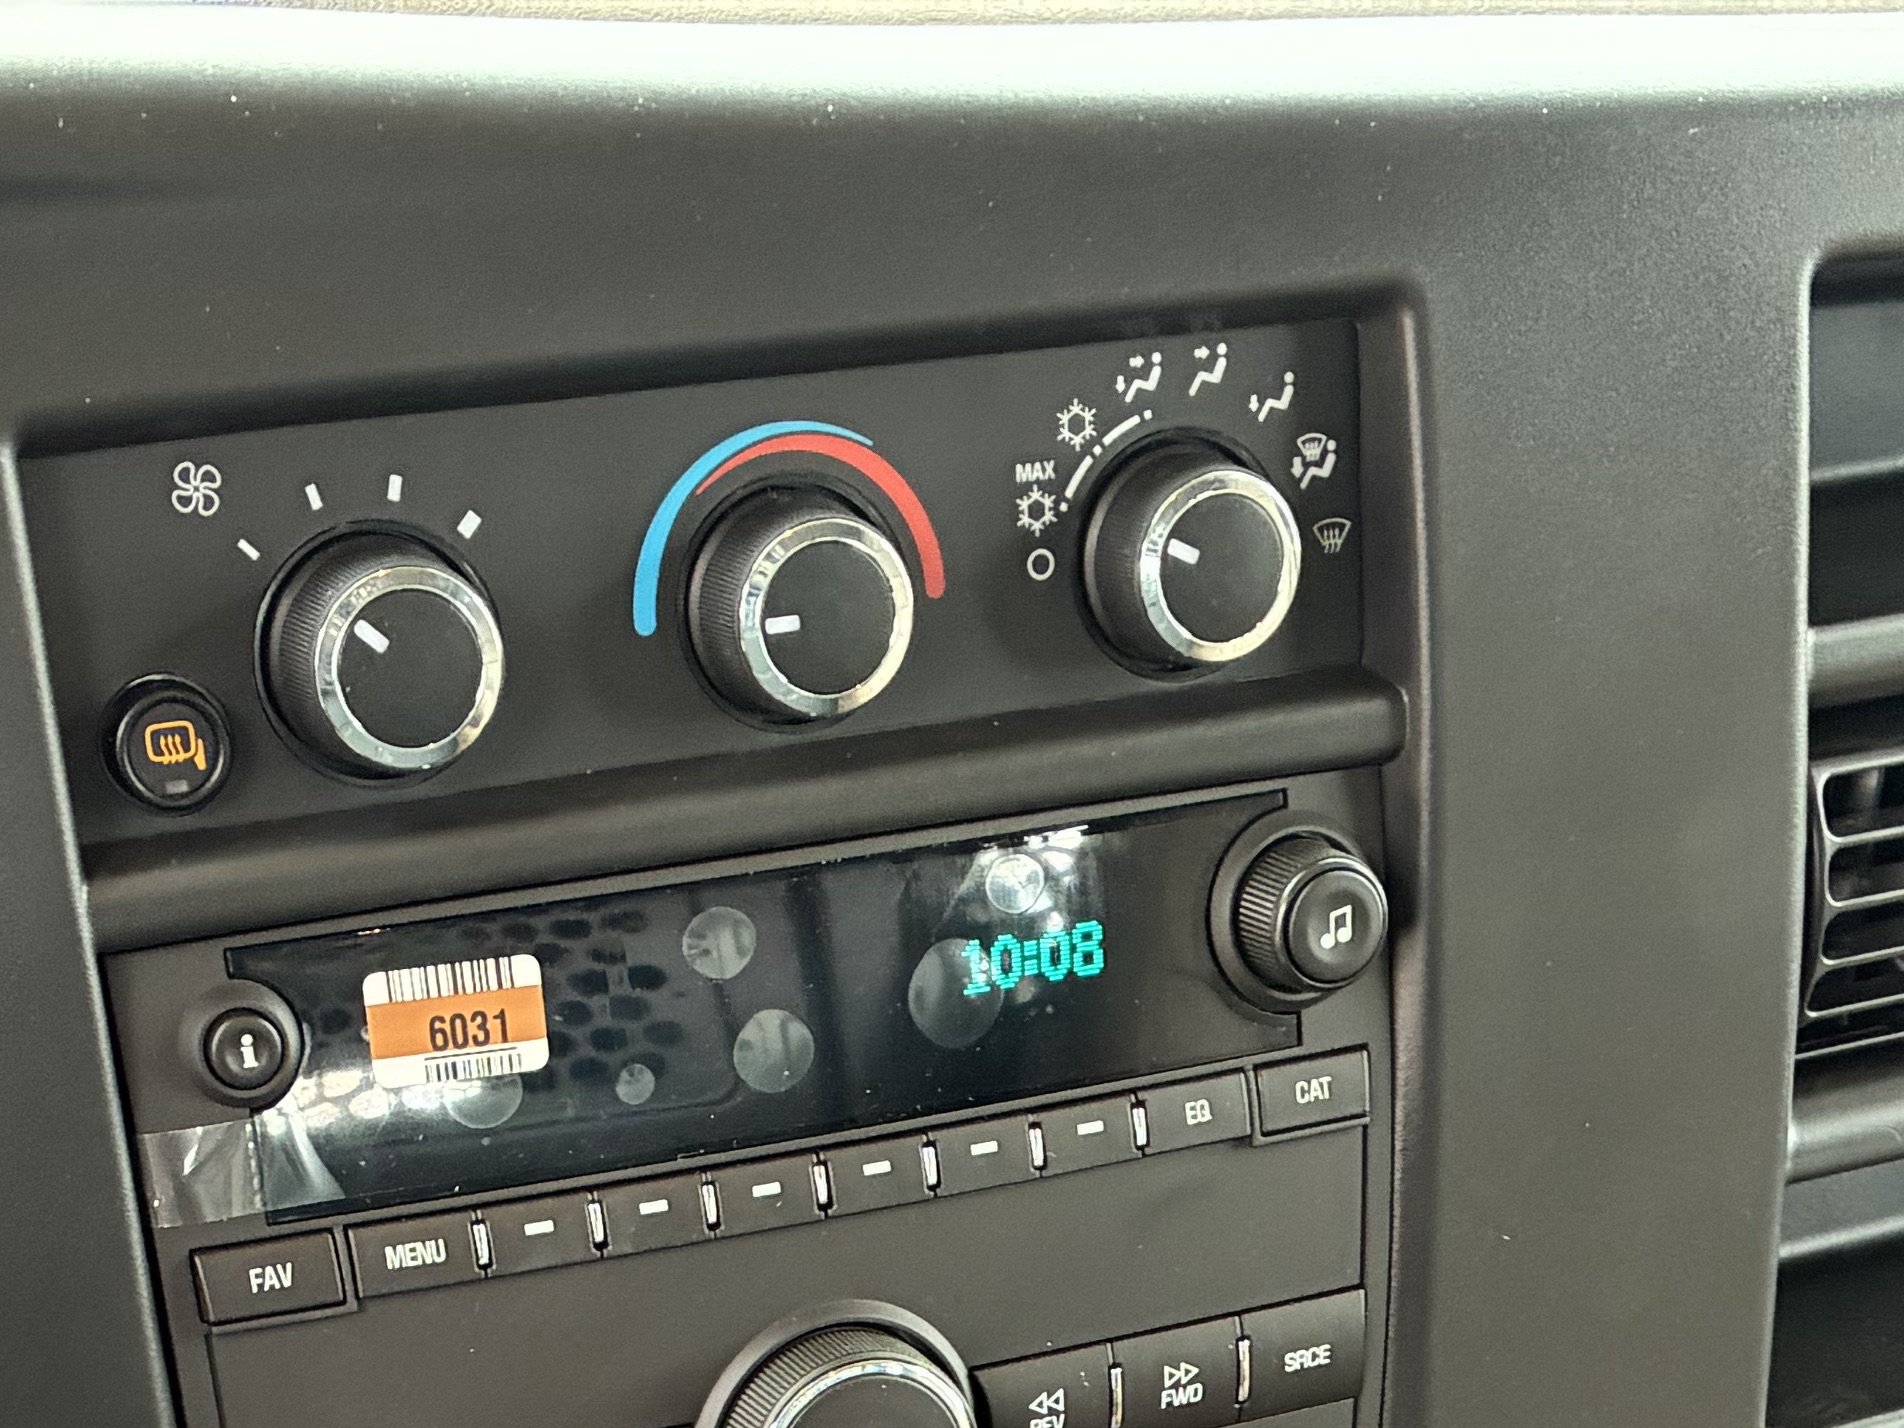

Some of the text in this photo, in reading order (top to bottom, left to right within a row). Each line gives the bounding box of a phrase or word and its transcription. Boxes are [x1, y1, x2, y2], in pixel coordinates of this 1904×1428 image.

[1015, 459, 1056, 483] MAX
[960, 919, 1105, 996] 10:08
[428, 1007, 510, 1052] 6031
[1295, 1075, 1333, 1104] CAT
[1184, 1098, 1213, 1126] EQ
[384, 1238, 447, 1271] MENU
[248, 1261, 294, 1294] FAV
[1284, 1343, 1332, 1373] SRCE
[1160, 1382, 1204, 1410] FWD
